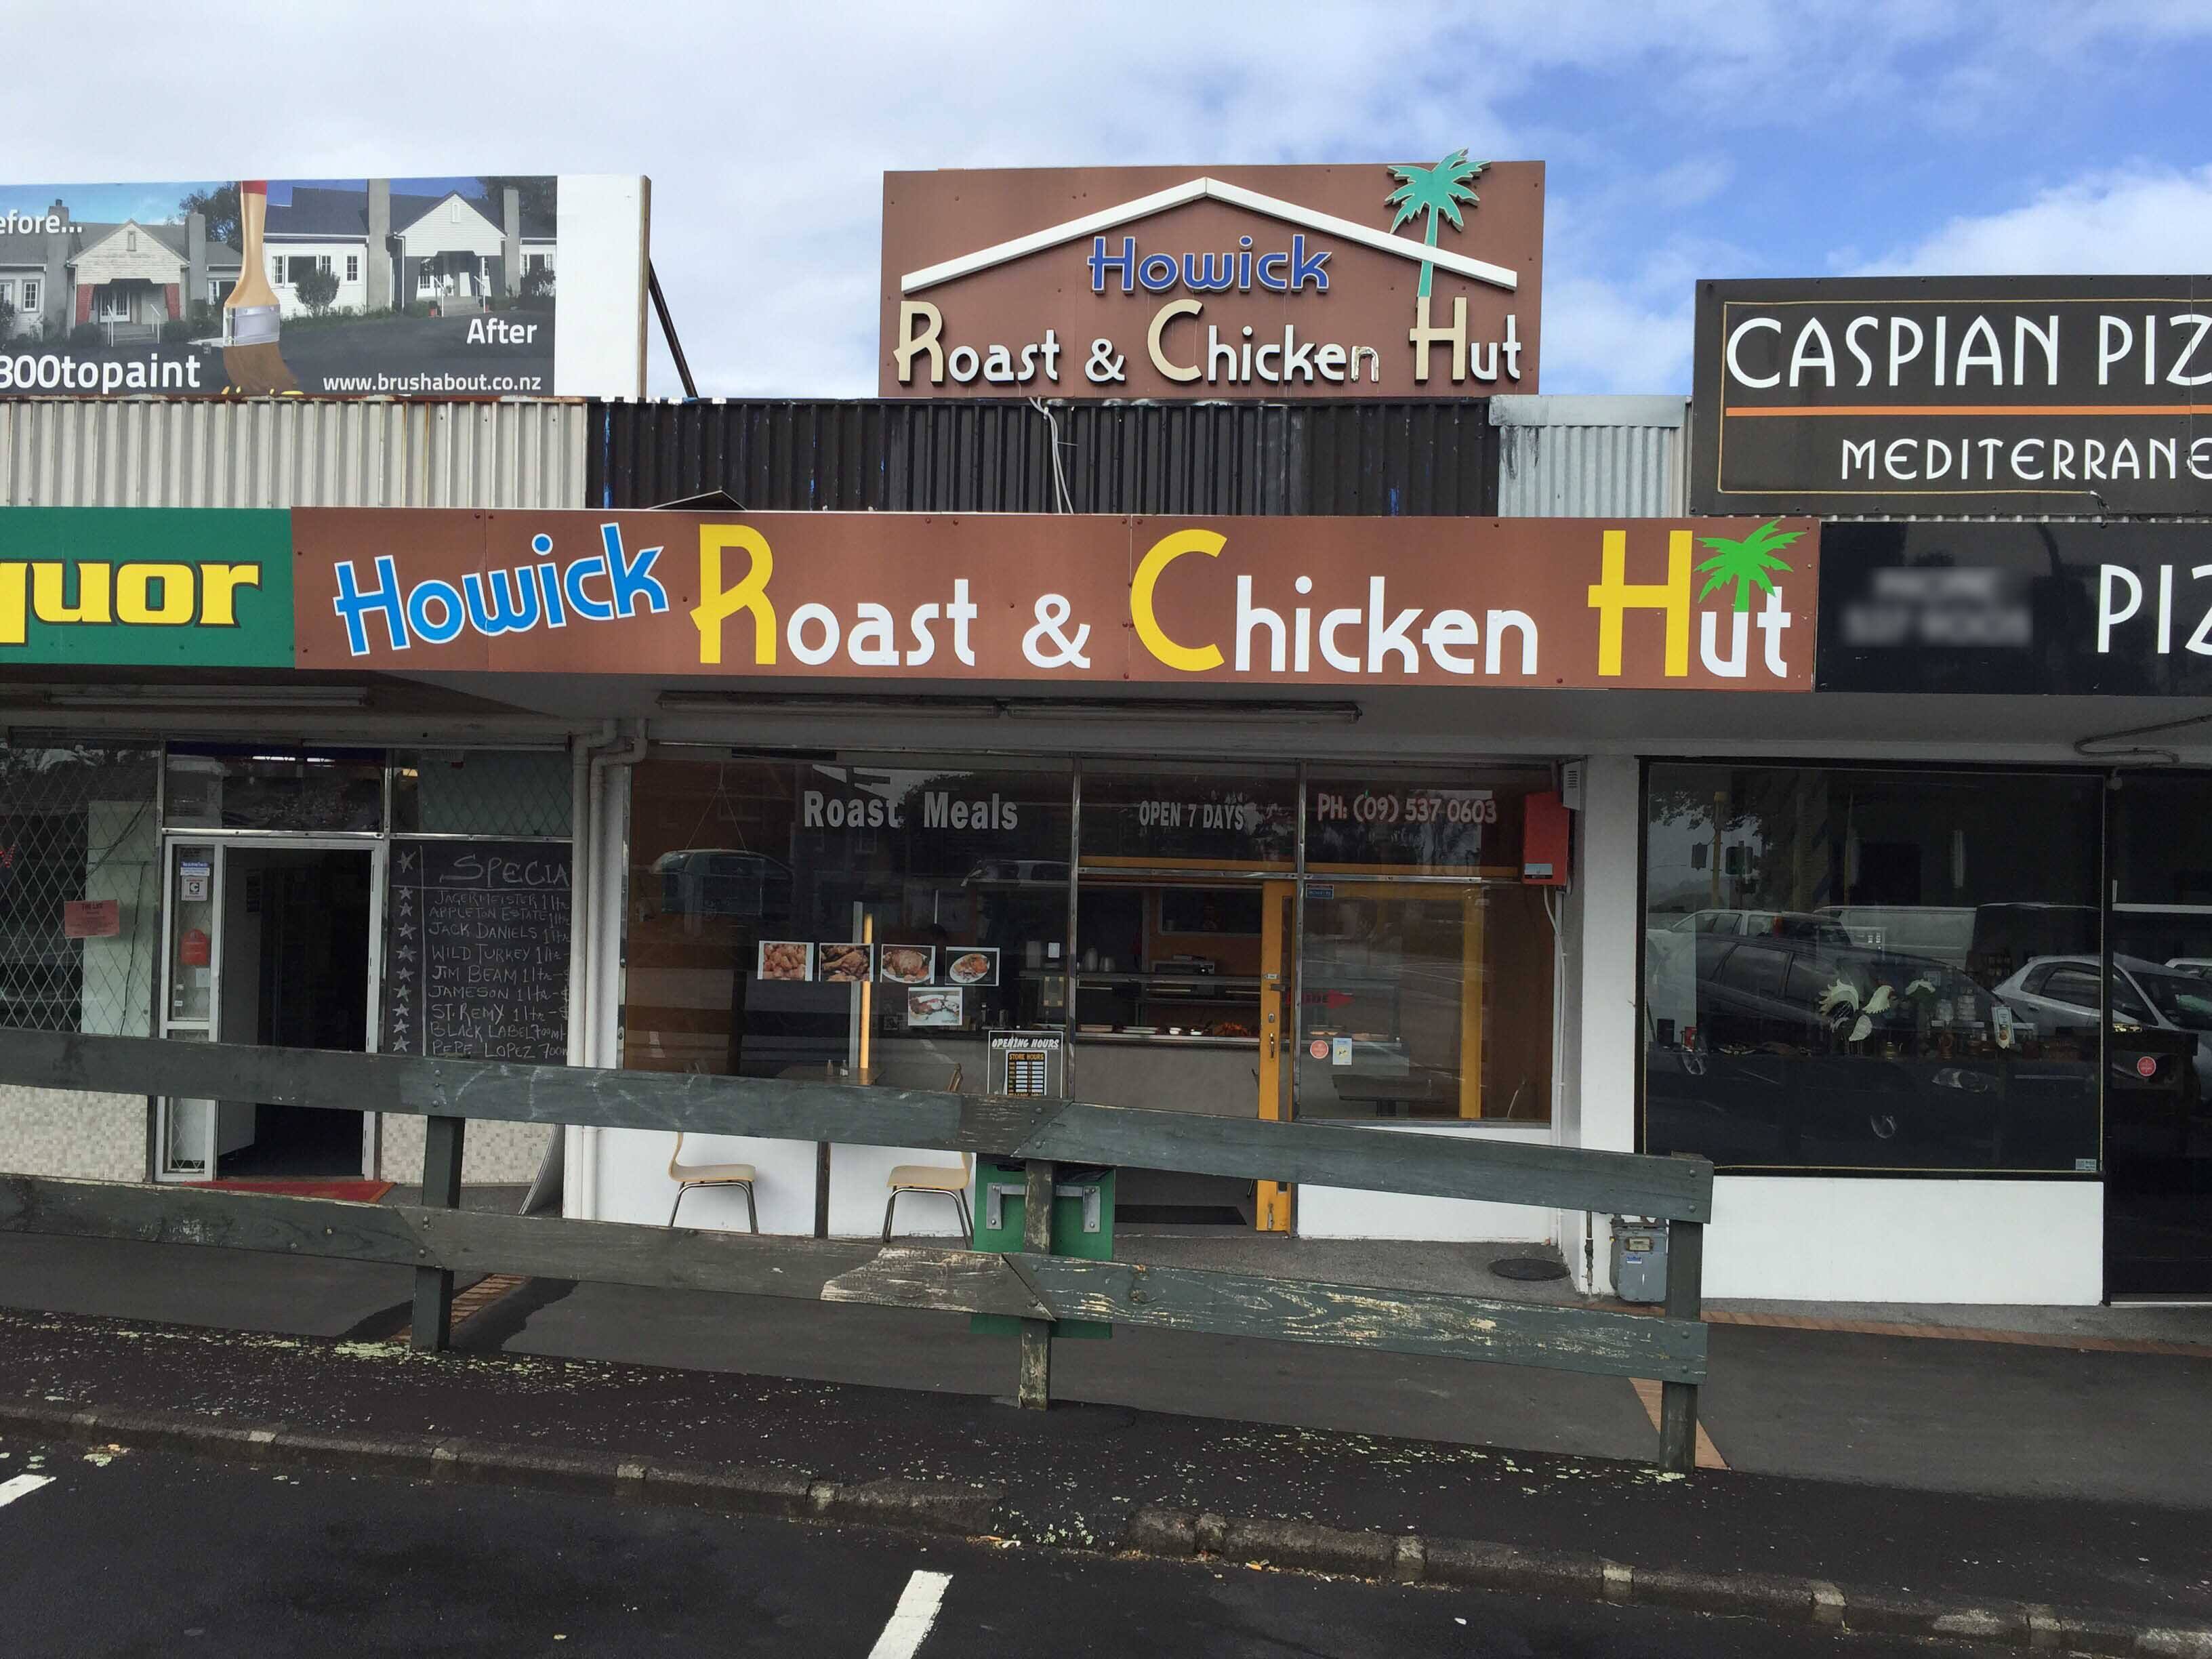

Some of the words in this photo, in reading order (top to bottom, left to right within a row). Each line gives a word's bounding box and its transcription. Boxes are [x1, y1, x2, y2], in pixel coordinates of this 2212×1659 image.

[1087, 234, 1332, 293] Howick
[466, 318, 537, 344] After
[893, 300, 1060, 384] Roast
[1085, 339, 1125, 382] &
[1147, 298, 1380, 384] Chicken
[1409, 296, 1521, 382] Hut
[1726, 315, 2059, 388] CASPIAN
[2098, 314, 2212, 386] PIZ
[323, 373, 541, 390] www.brushabout.co.nz
[1841, 437, 2212, 480] MEDITERRANE
[332, 523, 670, 657] Howick
[690, 523, 977, 667] Roast
[1021, 594, 1091, 668] &
[1130, 529, 1538, 675] Chicken
[1587, 529, 1791, 678] Hut
[804, 790, 903, 828] Roast
[923, 792, 1019, 830] Meals
[1139, 800, 1181, 827] OPEN
[1188, 802, 1199, 827] 7
[1203, 802, 1244, 830] DAYS
[1318, 794, 1347, 821] PH:
[1353, 794, 1399, 823] (09)
[1405, 798, 1441, 823] 537
[1447, 799, 1497, 824] 0603
[428, 922, 470, 937] JACK
[476, 922, 537, 939] DANIELS
[432, 945, 471, 962] WILD
[475, 943, 531, 964] TURKEY
[468, 965, 516, 985] BEAM
[430, 1021, 483, 1042] BLACK
[489, 1024, 536, 1041] LABEL
[991, 1038, 1029, 1048] OPENING
[1031, 1038, 1060, 1048] HOURS
[485, 1042, 536, 1059] LOPEZ
